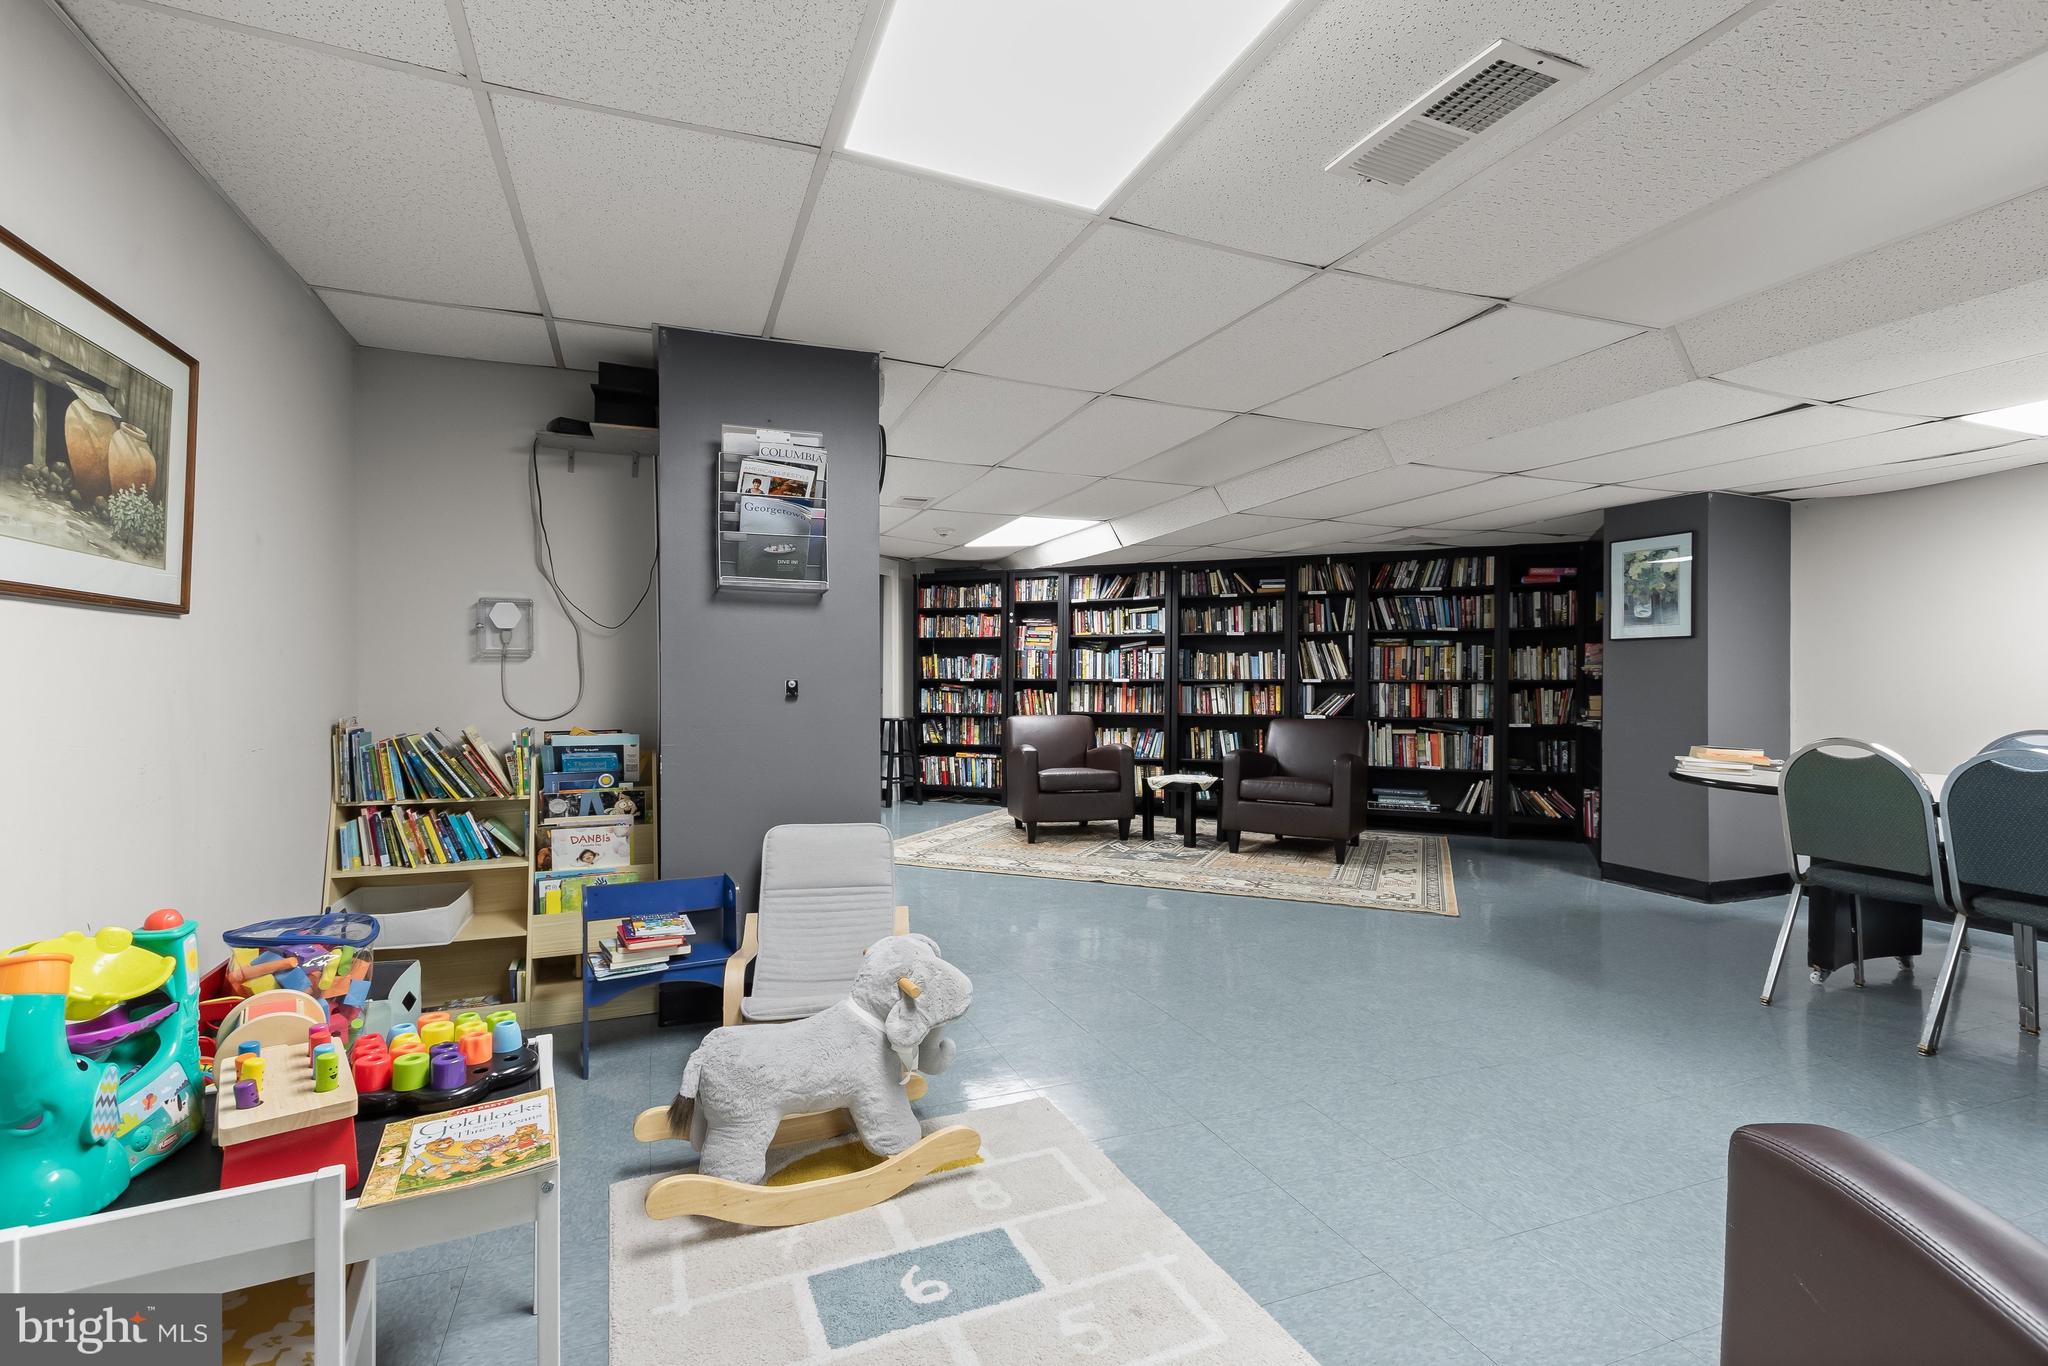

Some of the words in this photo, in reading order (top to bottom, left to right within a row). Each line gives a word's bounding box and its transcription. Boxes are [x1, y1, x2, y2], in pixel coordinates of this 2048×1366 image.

[760, 446, 824, 464] COLUMBIA
[744, 501, 807, 521] Georgetown
[413, 1103, 542, 1149] Goldilocks
[967, 1179, 1013, 1212] 8
[900, 1264, 950, 1305] 6
[1059, 1302, 1112, 1355] 5
